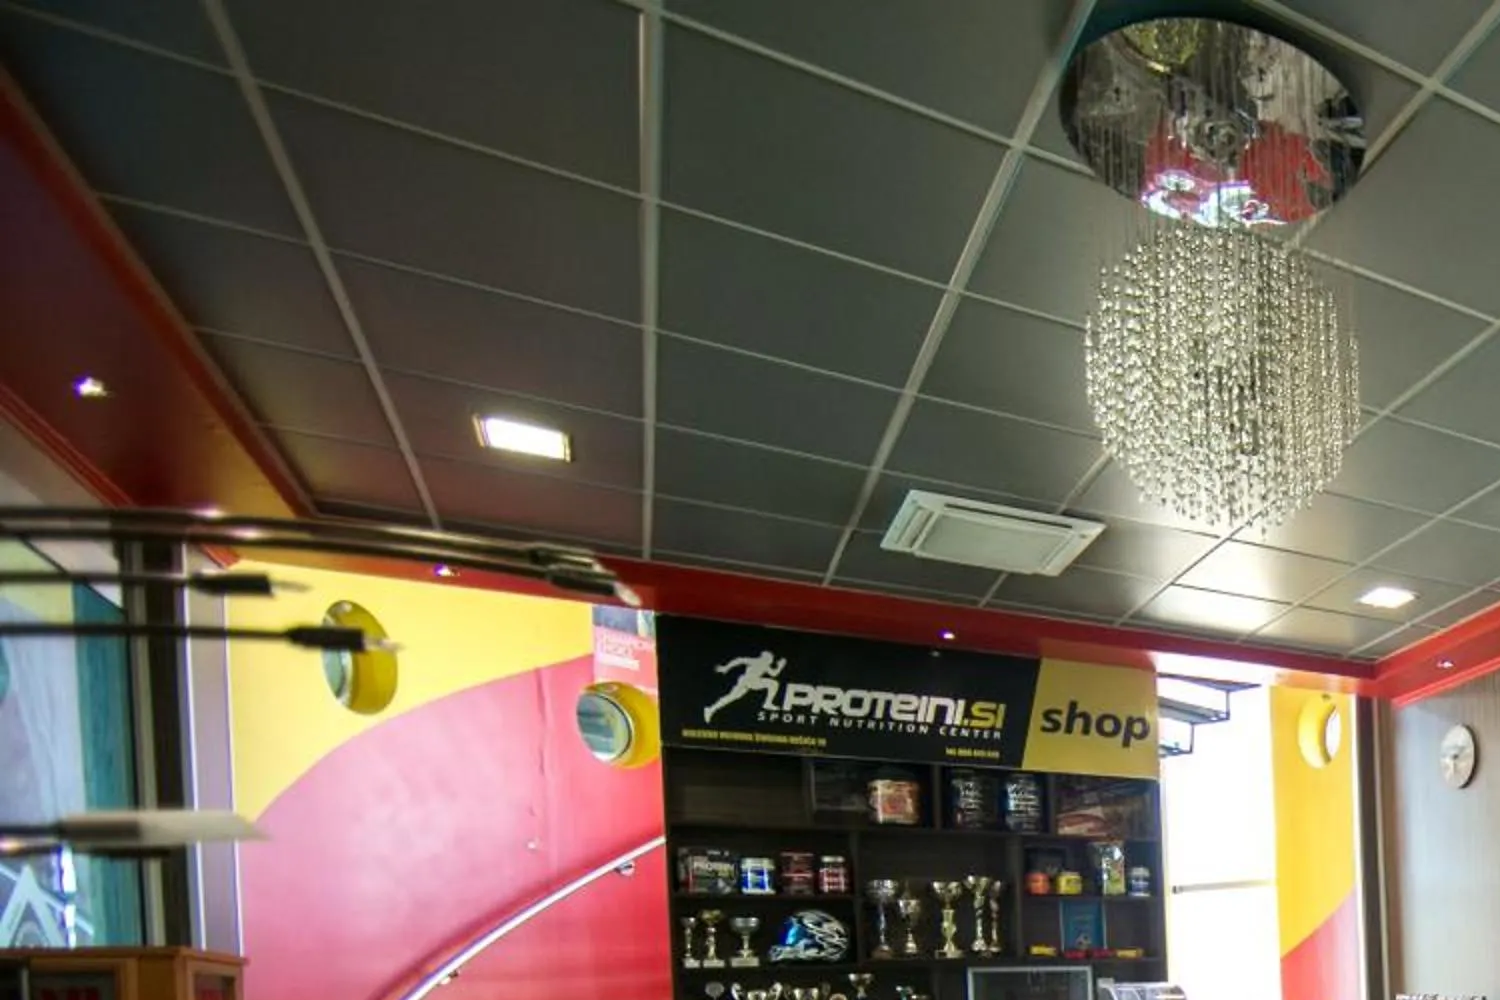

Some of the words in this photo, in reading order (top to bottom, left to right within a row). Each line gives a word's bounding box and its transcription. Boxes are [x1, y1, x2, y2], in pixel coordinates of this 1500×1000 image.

[757, 711, 819, 726] SPORT
[829, 716, 930, 735] NUTRITION
[938, 725, 1002, 741] CENTER
[1040, 700, 1151, 748] shop
